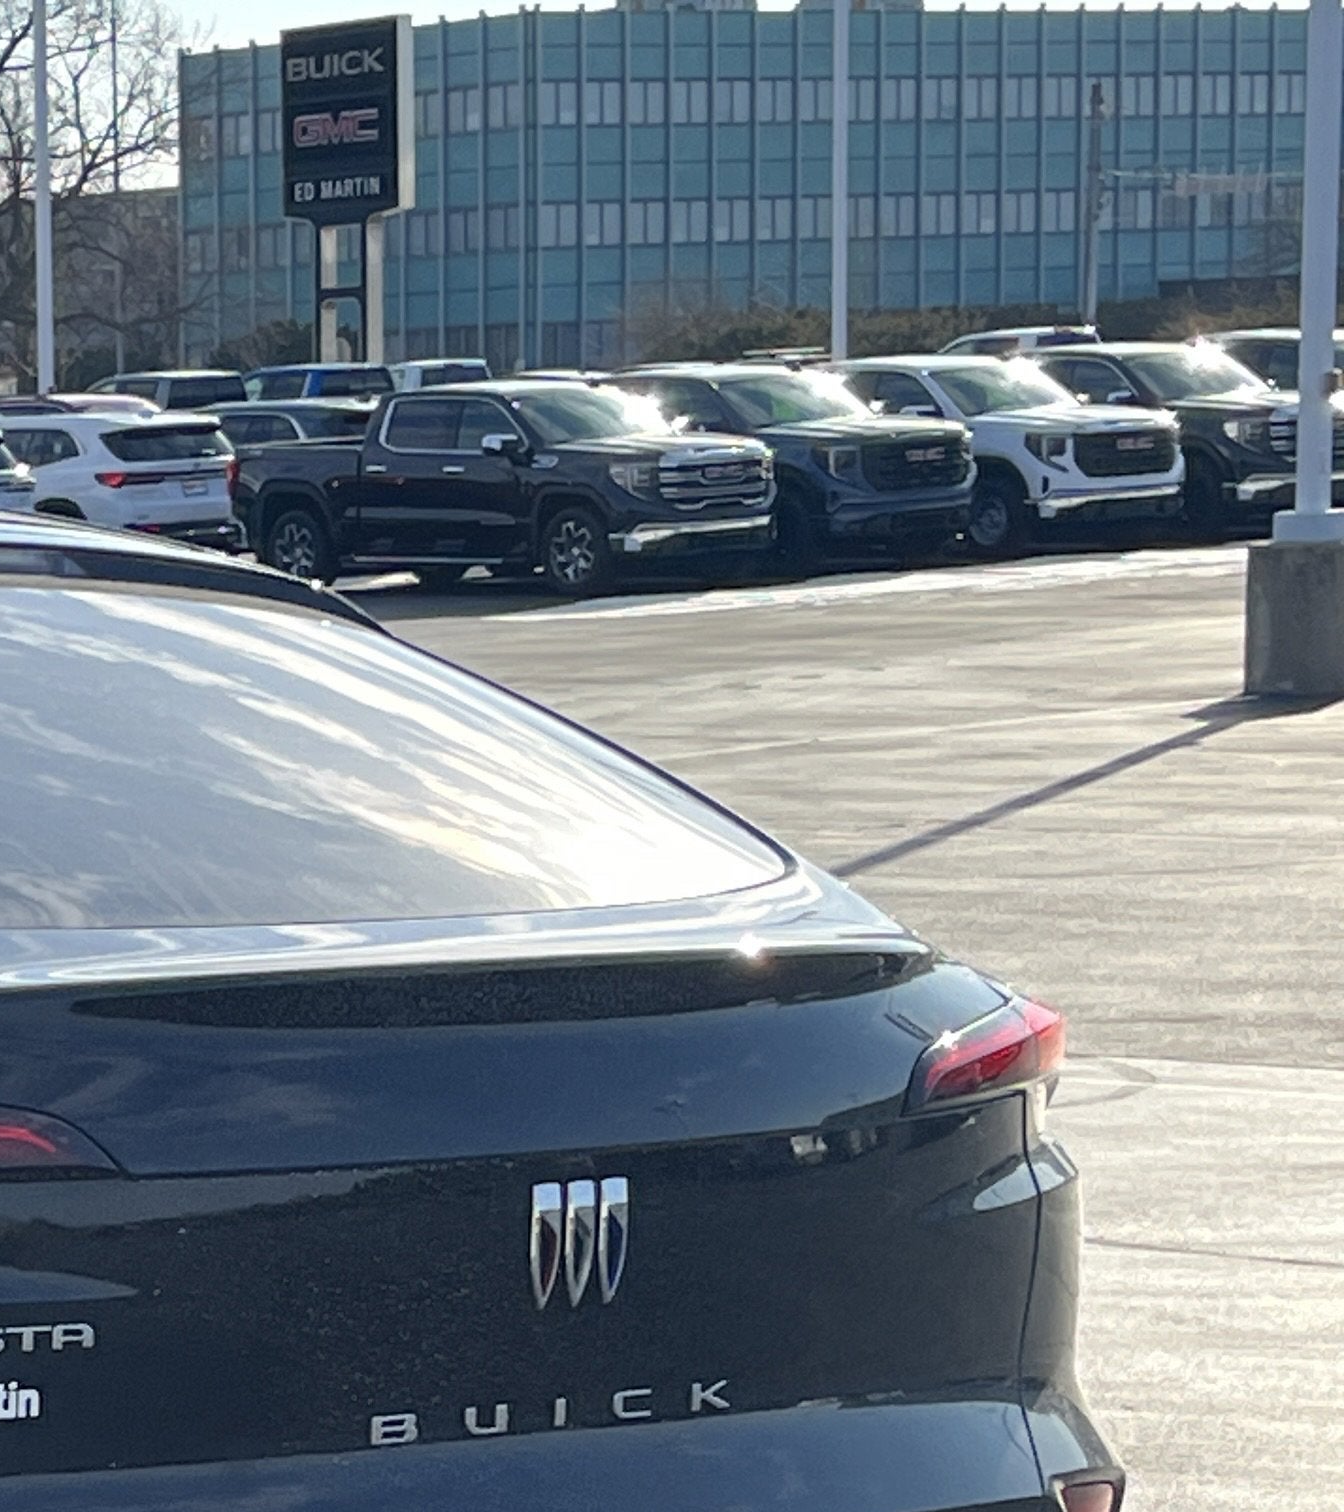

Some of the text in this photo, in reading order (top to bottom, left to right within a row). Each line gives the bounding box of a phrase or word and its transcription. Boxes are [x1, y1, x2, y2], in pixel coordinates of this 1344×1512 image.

[285, 47, 384, 82] BUICK
[293, 108, 379, 148] GMC
[294, 176, 381, 202] ED MARTIN
[370, 1378, 731, 1446] BUICK
